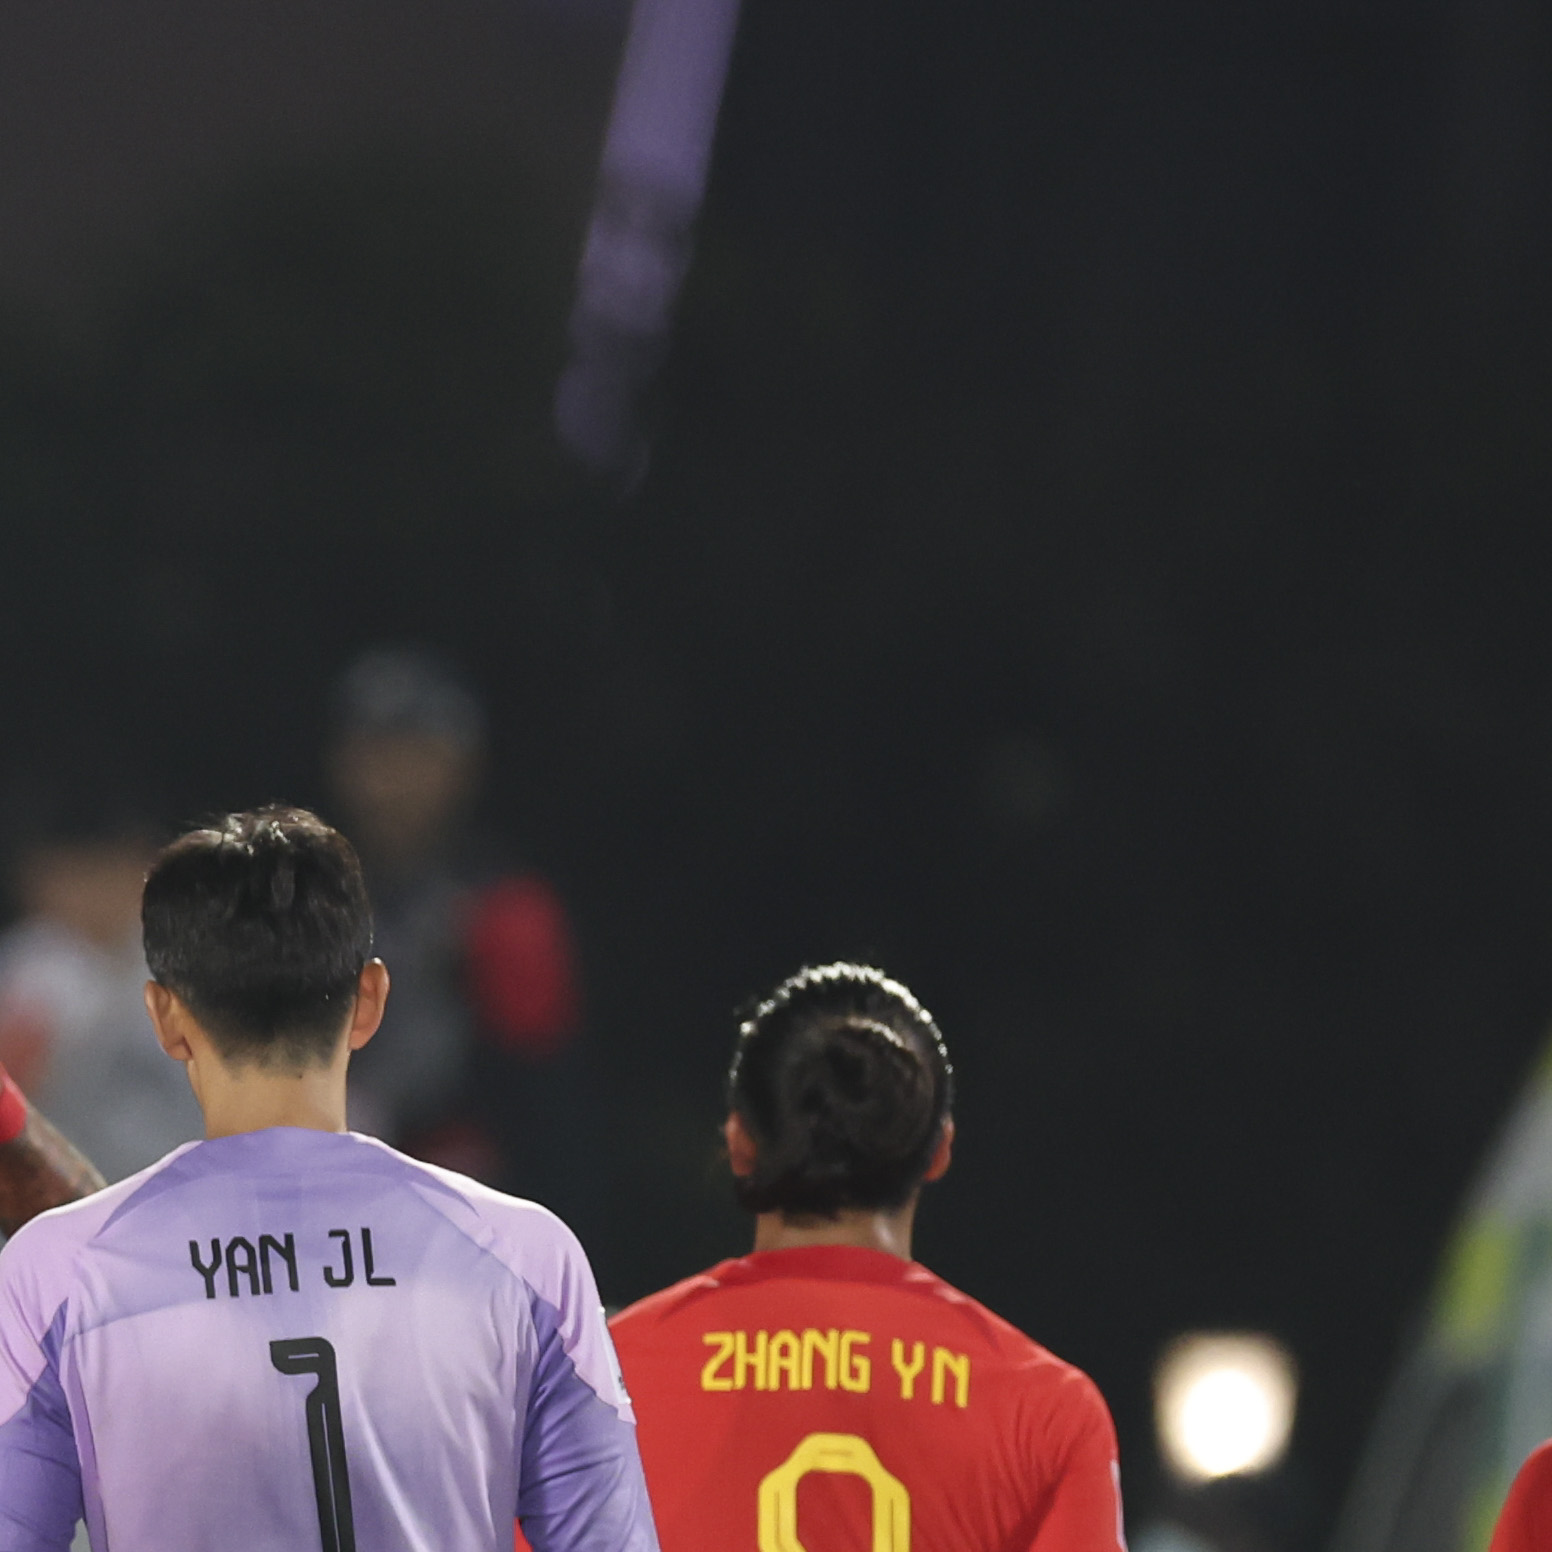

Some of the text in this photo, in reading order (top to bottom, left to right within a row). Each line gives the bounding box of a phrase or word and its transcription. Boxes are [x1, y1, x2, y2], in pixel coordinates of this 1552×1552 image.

[188, 1227, 397, 1300] YAN JL
[701, 1328, 971, 1409] ZHANG YN
